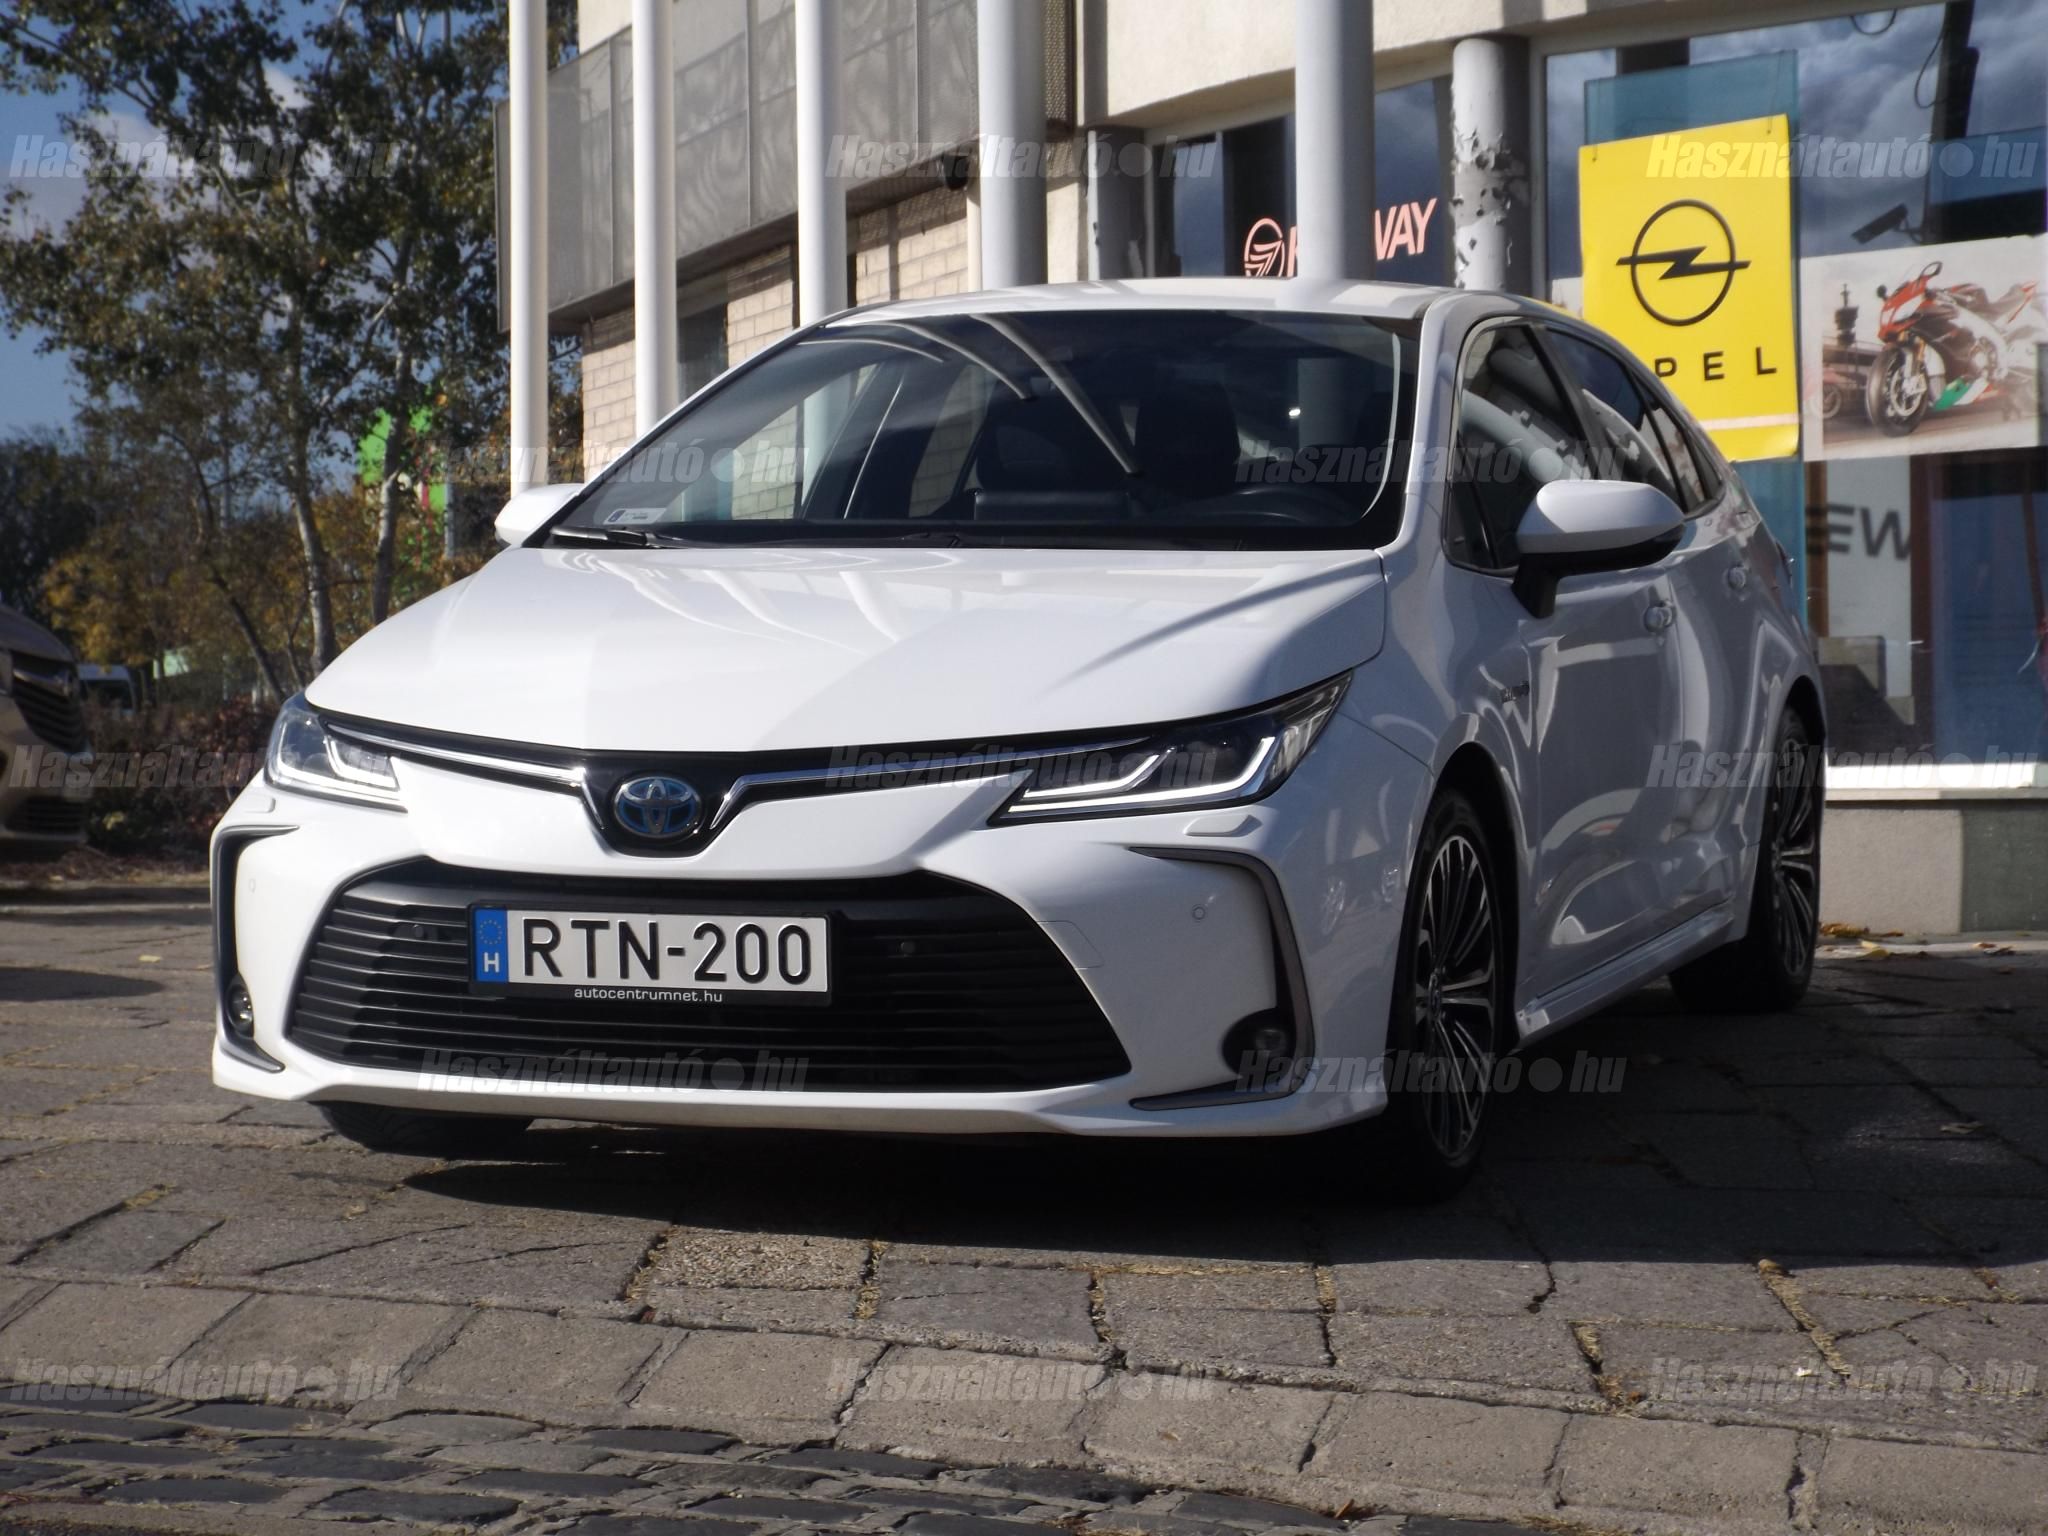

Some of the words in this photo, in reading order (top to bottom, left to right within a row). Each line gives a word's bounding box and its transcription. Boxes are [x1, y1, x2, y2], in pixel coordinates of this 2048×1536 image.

[1654, 346, 1777, 381] PEL
[483, 951, 500, 973] H
[522, 917, 811, 985] RTN-200
[574, 987, 723, 1003] autocentrumnet.hu
